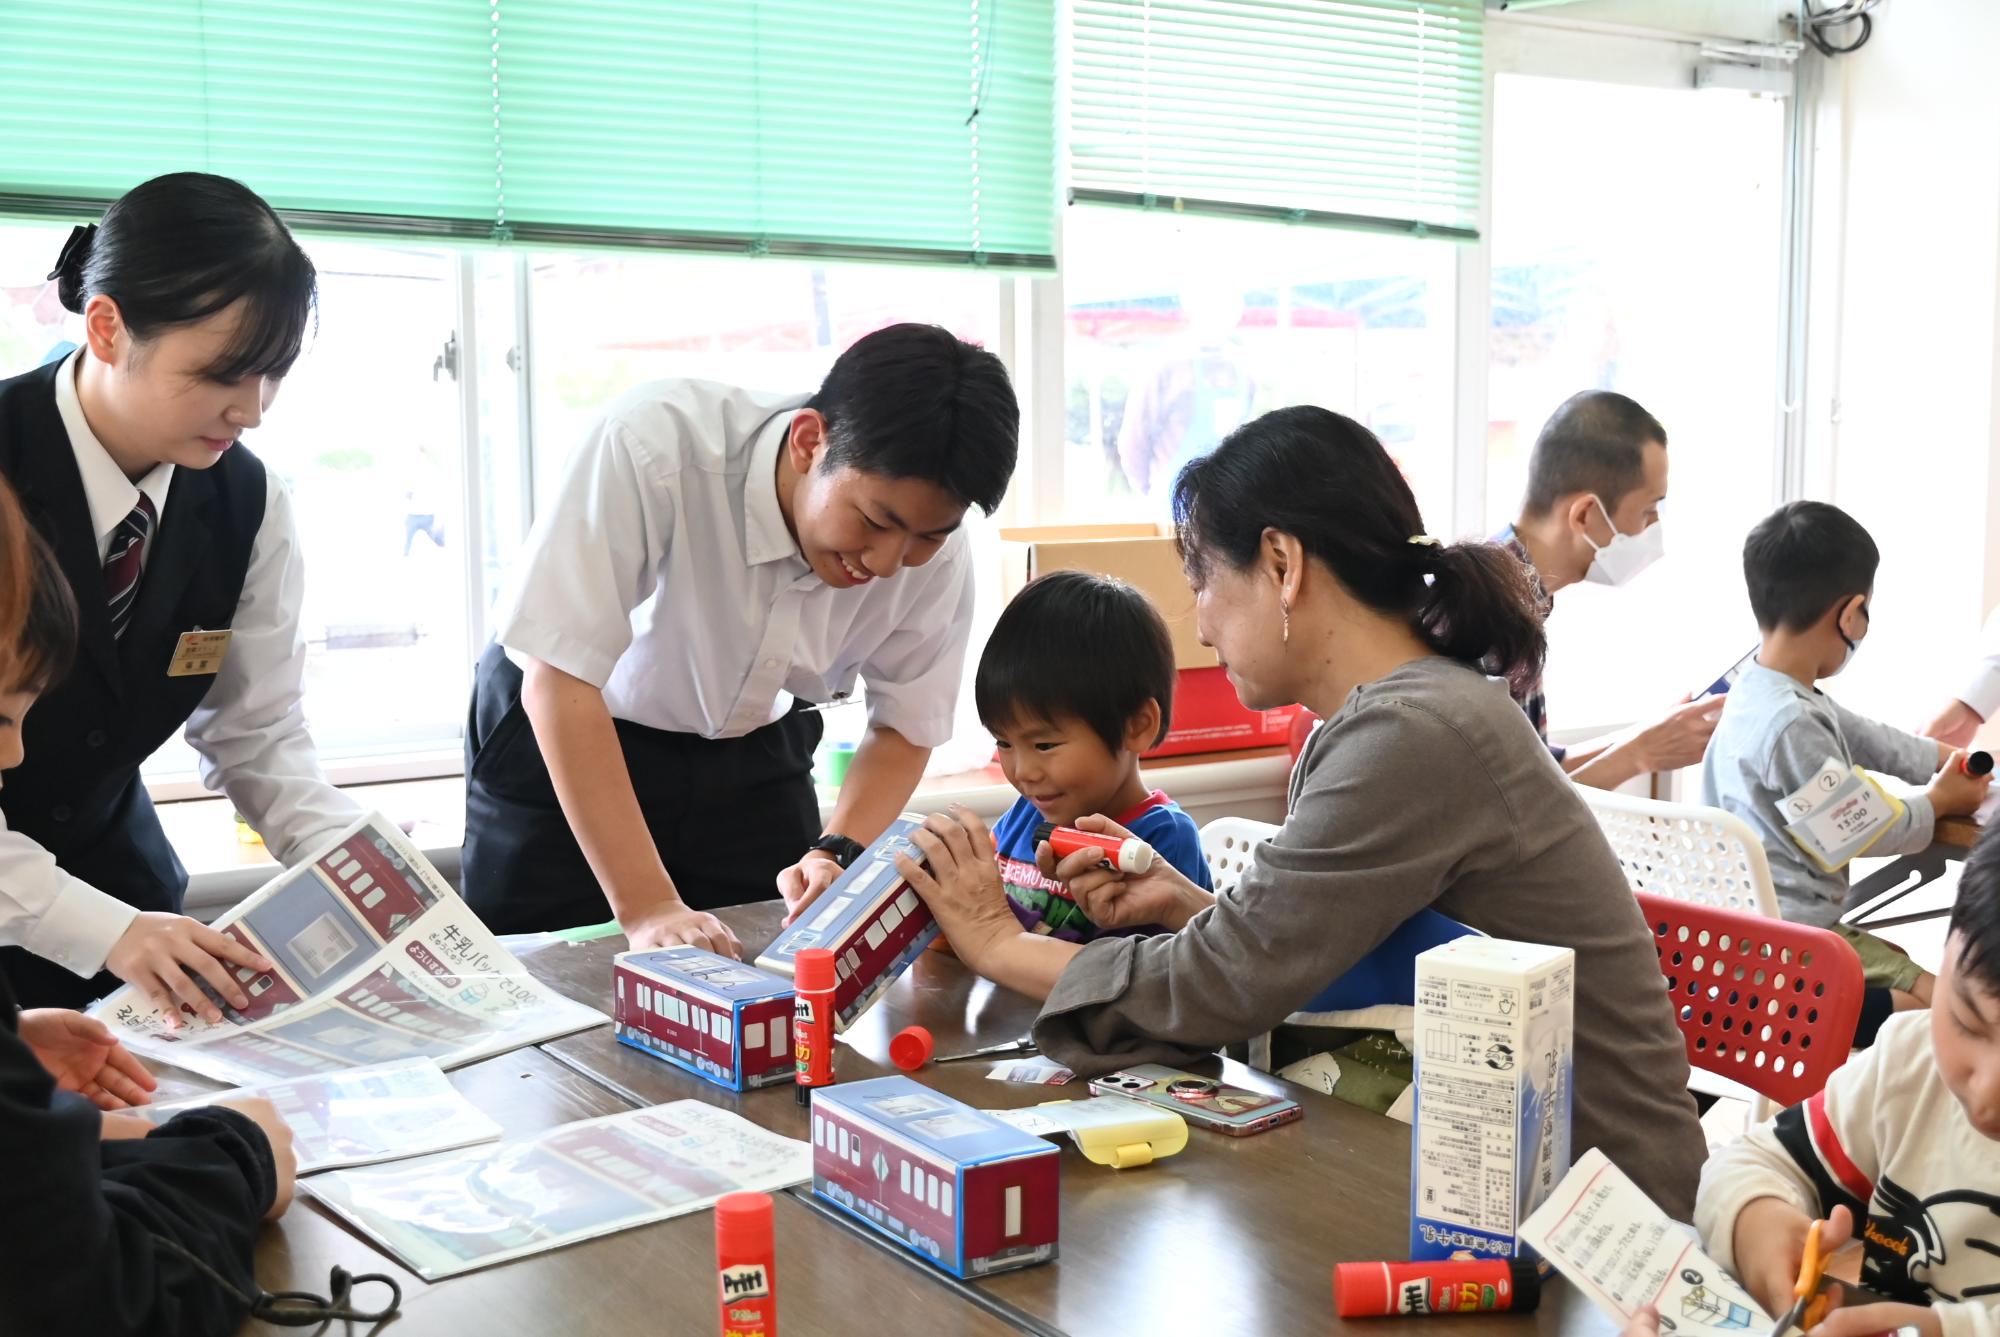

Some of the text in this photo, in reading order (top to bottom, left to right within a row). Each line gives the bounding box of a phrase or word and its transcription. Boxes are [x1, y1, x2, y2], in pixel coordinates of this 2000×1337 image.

[1419, 1224, 1512, 1256] 成分無調整牛乳
[723, 1270, 762, 1294] Pritt
